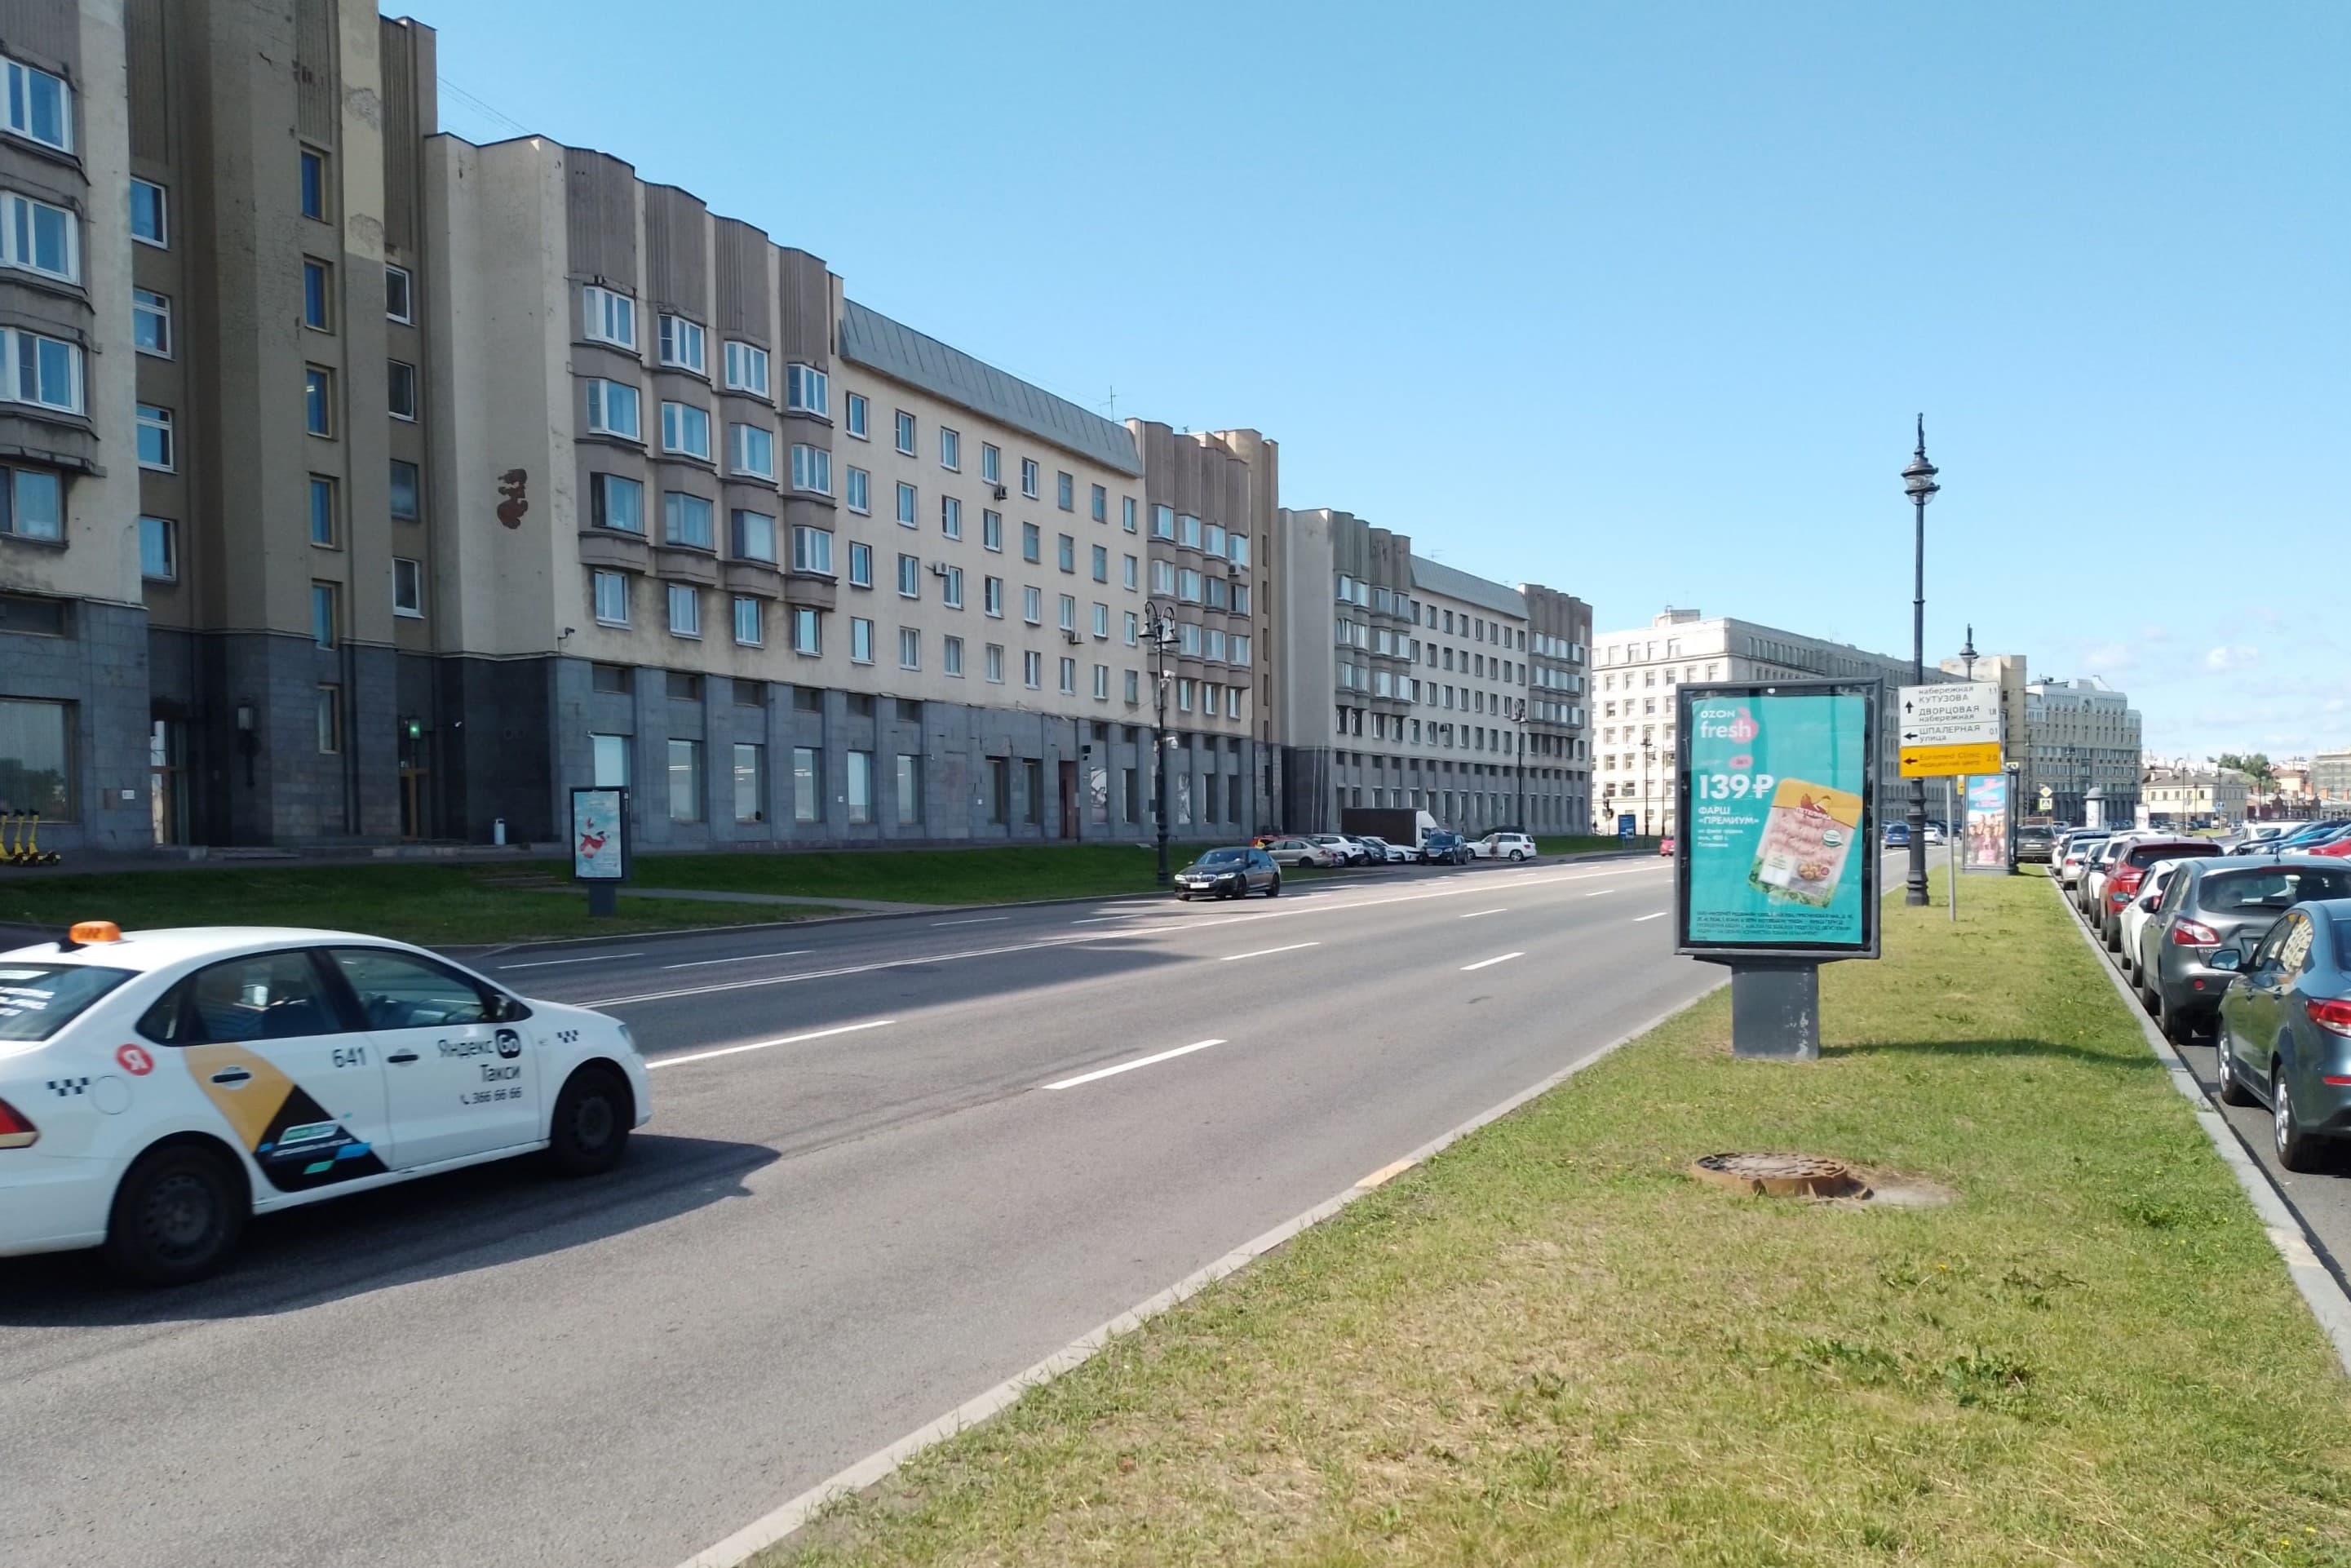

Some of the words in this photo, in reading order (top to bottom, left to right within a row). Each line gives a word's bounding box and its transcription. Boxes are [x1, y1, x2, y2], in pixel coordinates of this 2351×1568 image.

[1919, 686, 1974, 695] набережная
[1919, 693, 1969, 703] КУТУЗОВА
[1919, 705, 1980, 716] ДВОРЦОВАЯ
[1919, 714, 1975, 723] набережная
[1700, 720, 1751, 738] fresh
[1919, 724, 1981, 735] ШПАЛЕРНАЯ
[1919, 734, 1946, 743] улица
[1698, 806, 1730, 815] ФАРШ
[332, 1048, 366, 1068] 641
[480, 1064, 520, 1082] Такси
